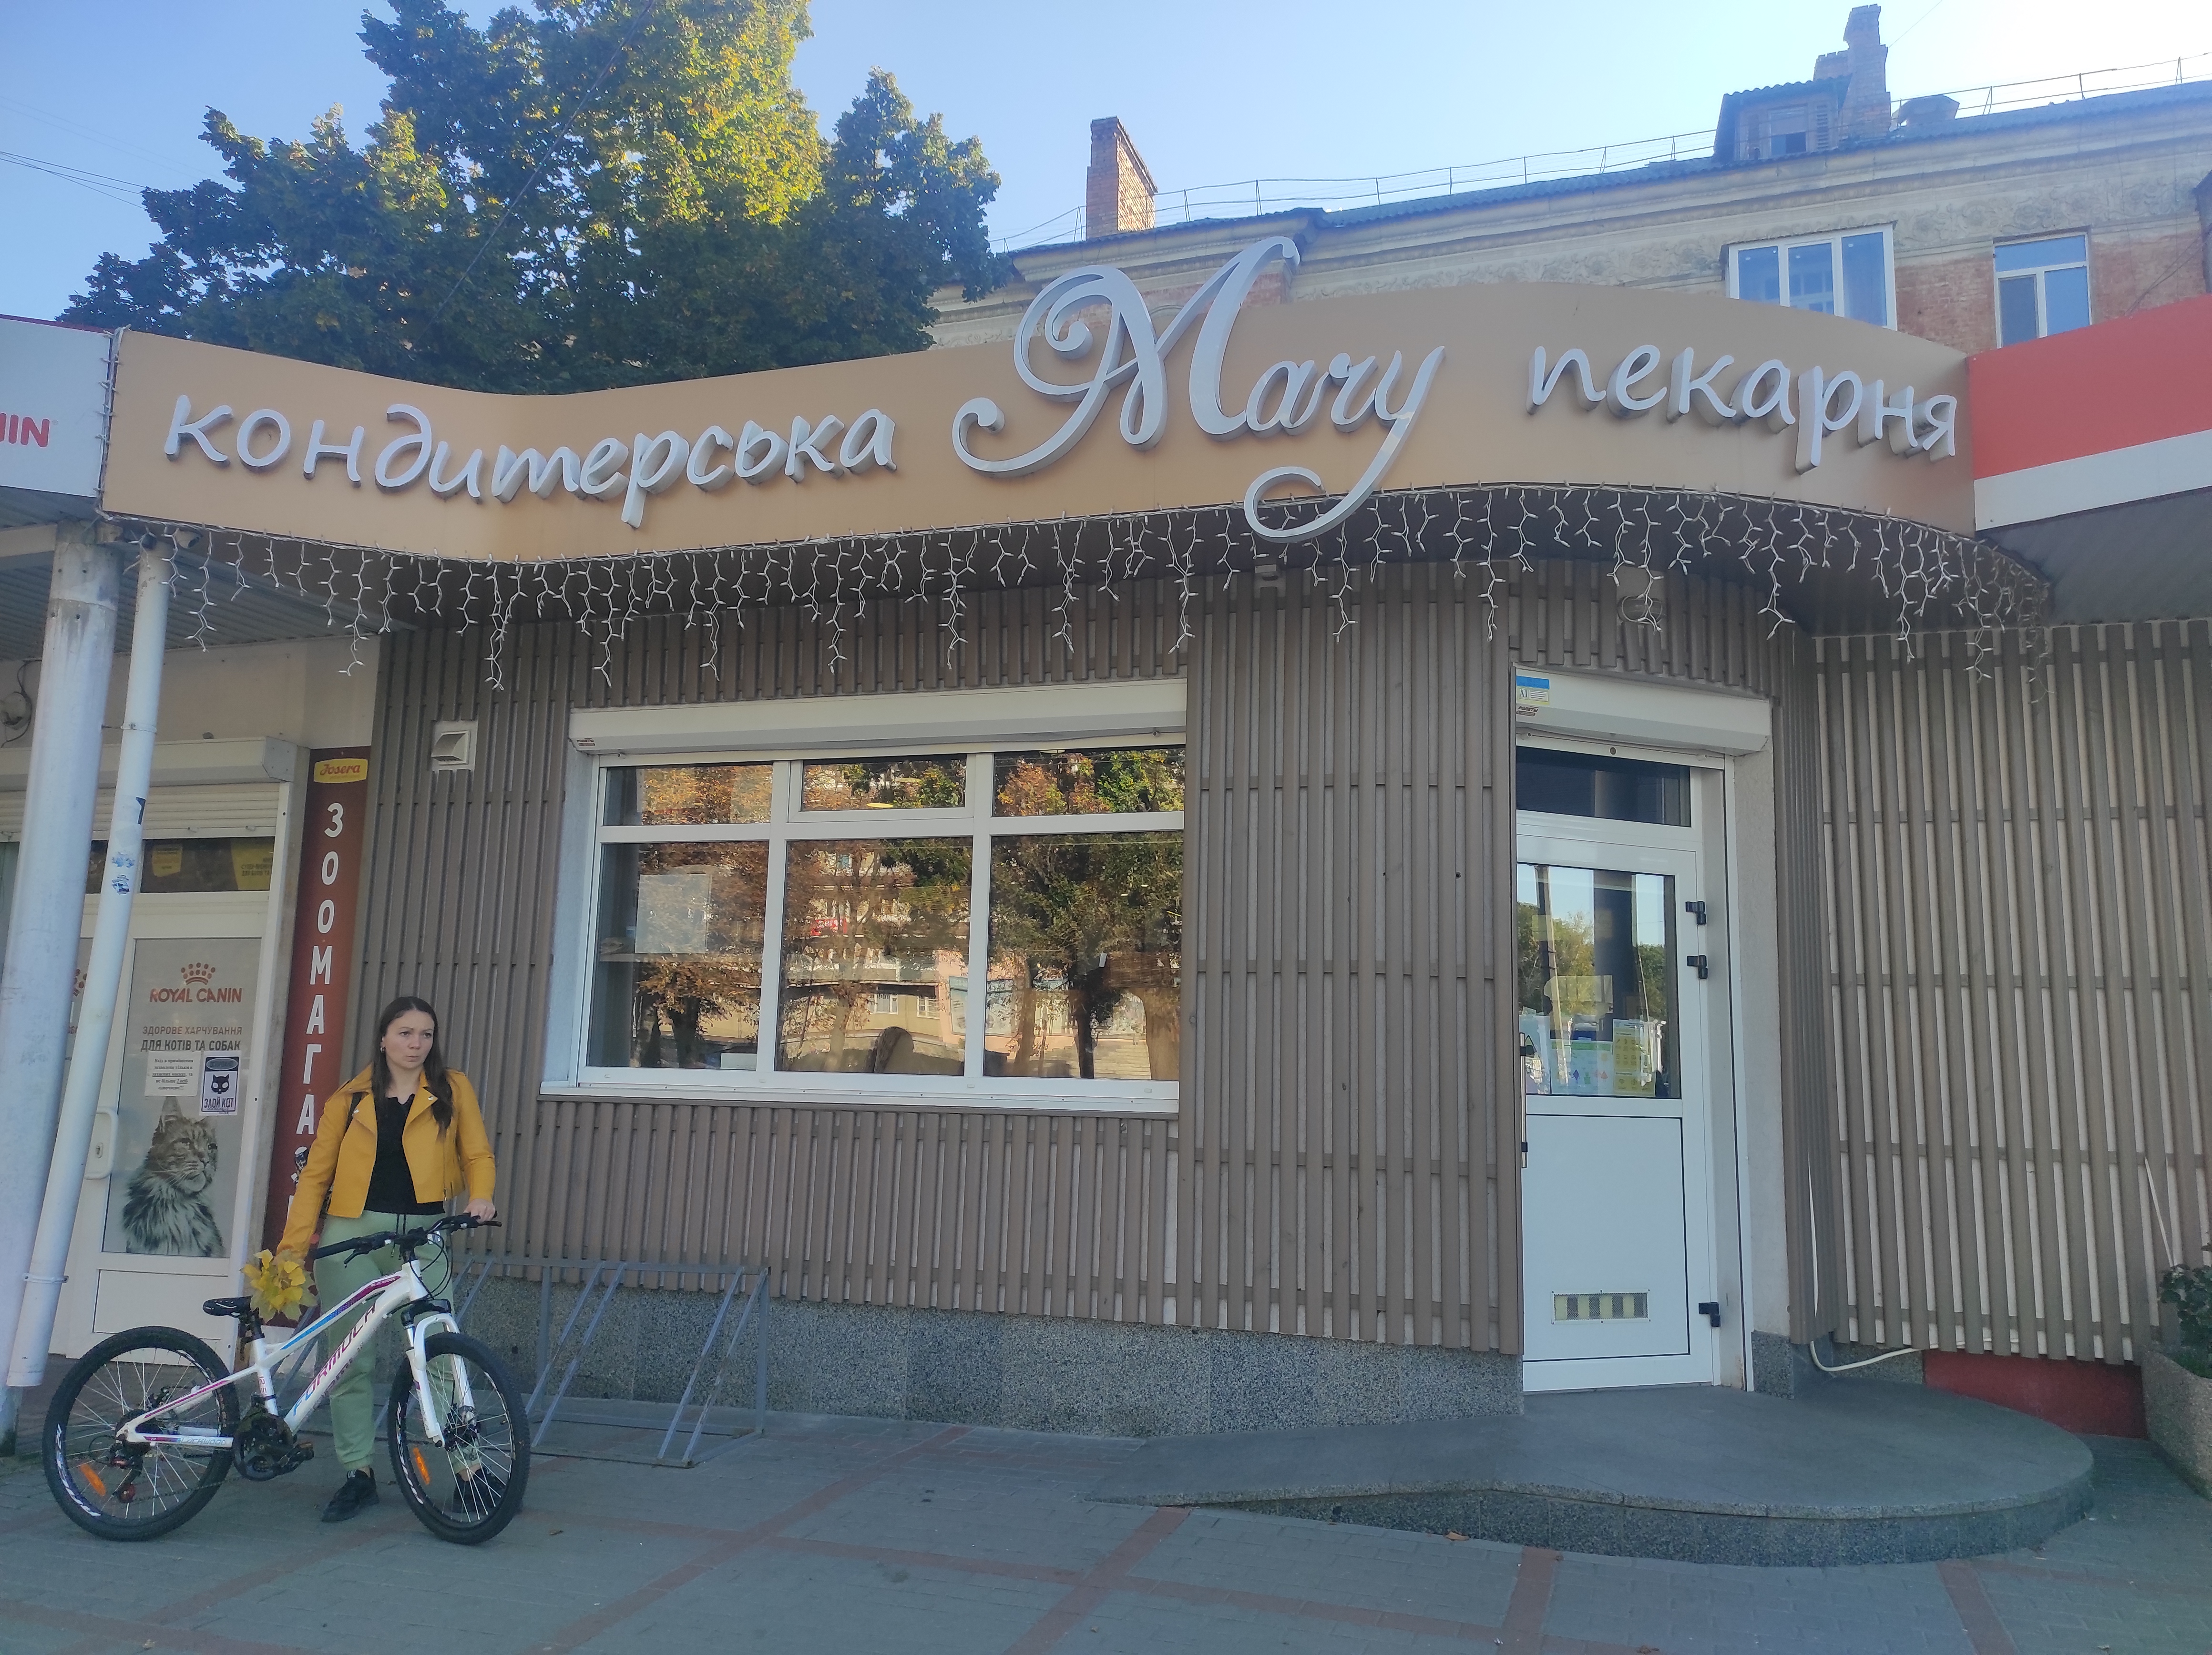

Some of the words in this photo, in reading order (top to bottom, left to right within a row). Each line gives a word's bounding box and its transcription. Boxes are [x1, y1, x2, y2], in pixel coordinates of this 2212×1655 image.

[952, 235, 1446, 543] Mary
[1526, 344, 1957, 475] пекарня
[164, 394, 897, 529] кондитерська
[320, 764, 360, 776] Josera
[149, 988, 193, 1002] ROYAL
[196, 988, 242, 1002] CANIN
[287, 802, 344, 1220] ЗООМАГА
[143, 1026, 182, 1036] ЗДОРОВЕ
[184, 1026, 242, 1035] ХАРЧУВАННЯ
[140, 1040, 161, 1052] ДЛЯ
[164, 1040, 192, 1051] КОТІВ
[195, 1040, 205, 1051] ТА
[209, 1040, 241, 1051] СОБАК
[204, 1096, 220, 1108] ЗЛОЙ
[222, 1098, 234, 1108] КОТ
